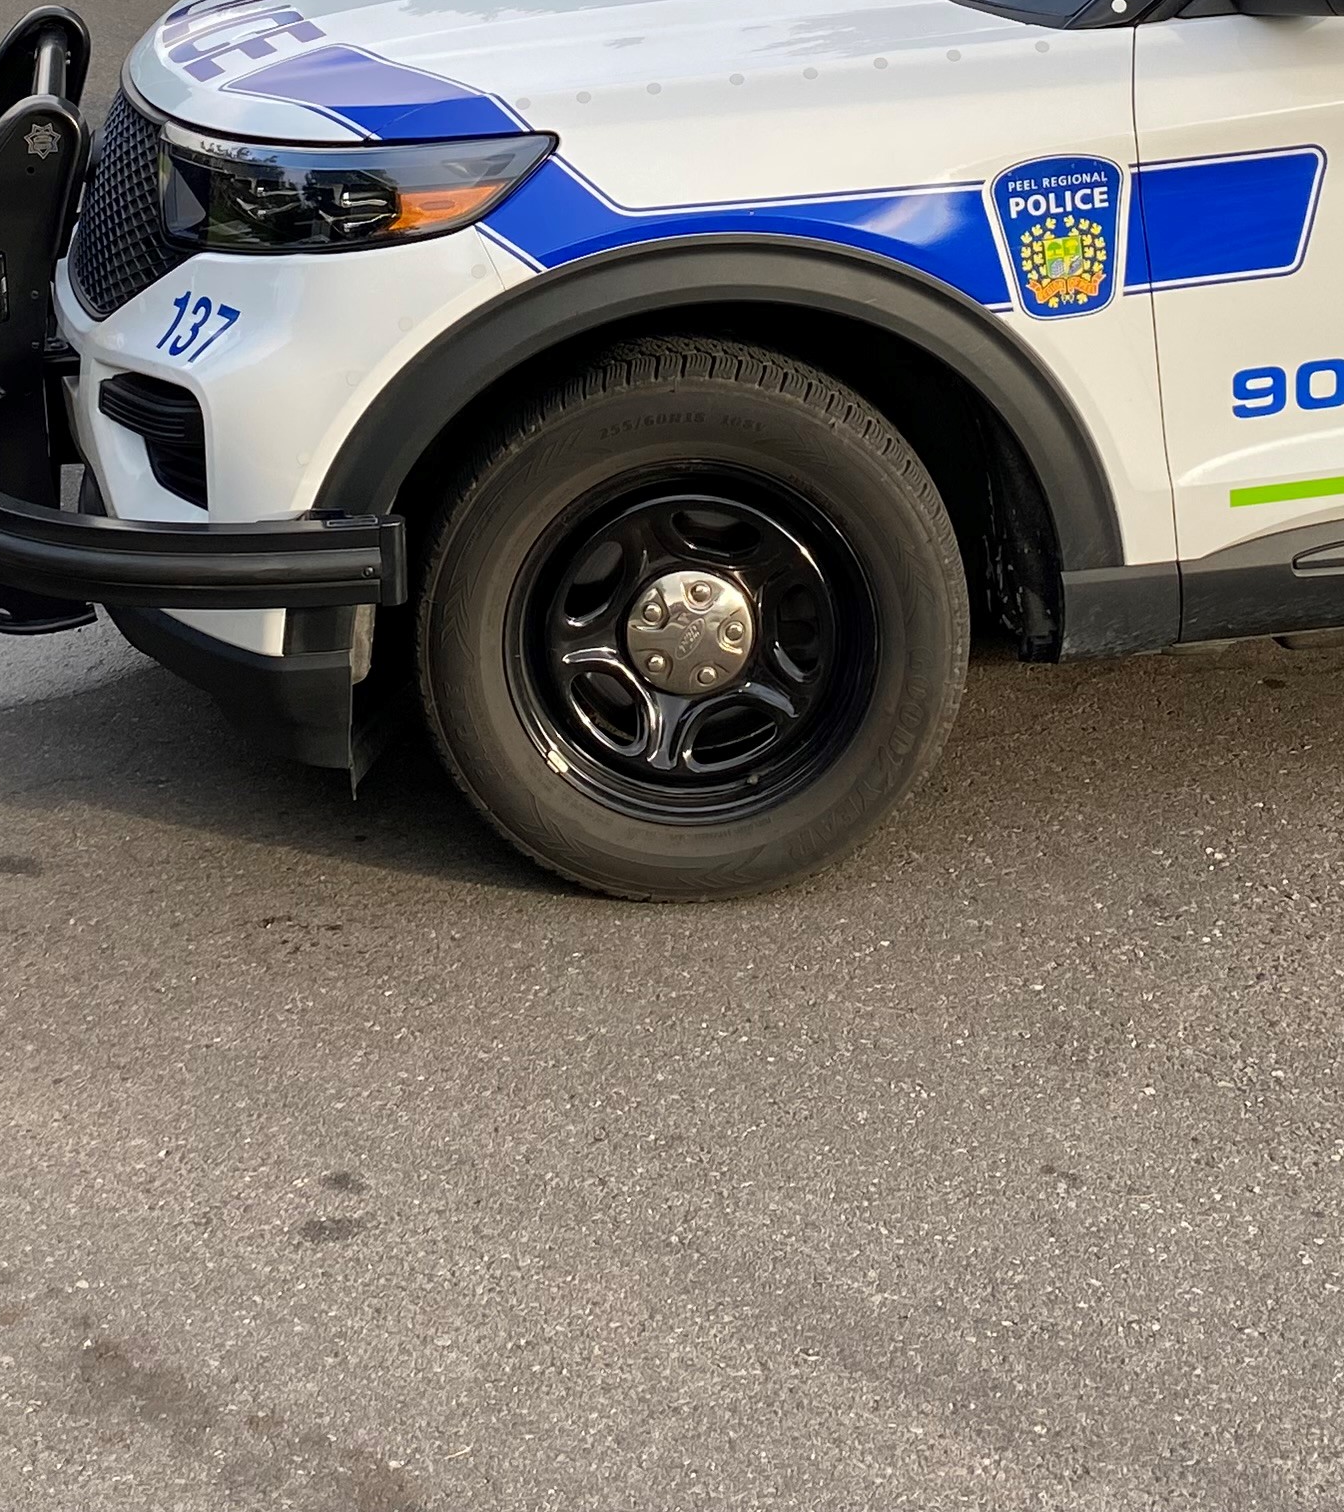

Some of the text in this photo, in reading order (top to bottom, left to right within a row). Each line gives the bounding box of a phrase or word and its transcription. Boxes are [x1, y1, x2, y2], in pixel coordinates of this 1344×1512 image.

[1008, 171, 1109, 193] PEEL REGIONAL
[1009, 186, 1110, 220] POLICE
[156, 291, 241, 363] 137
